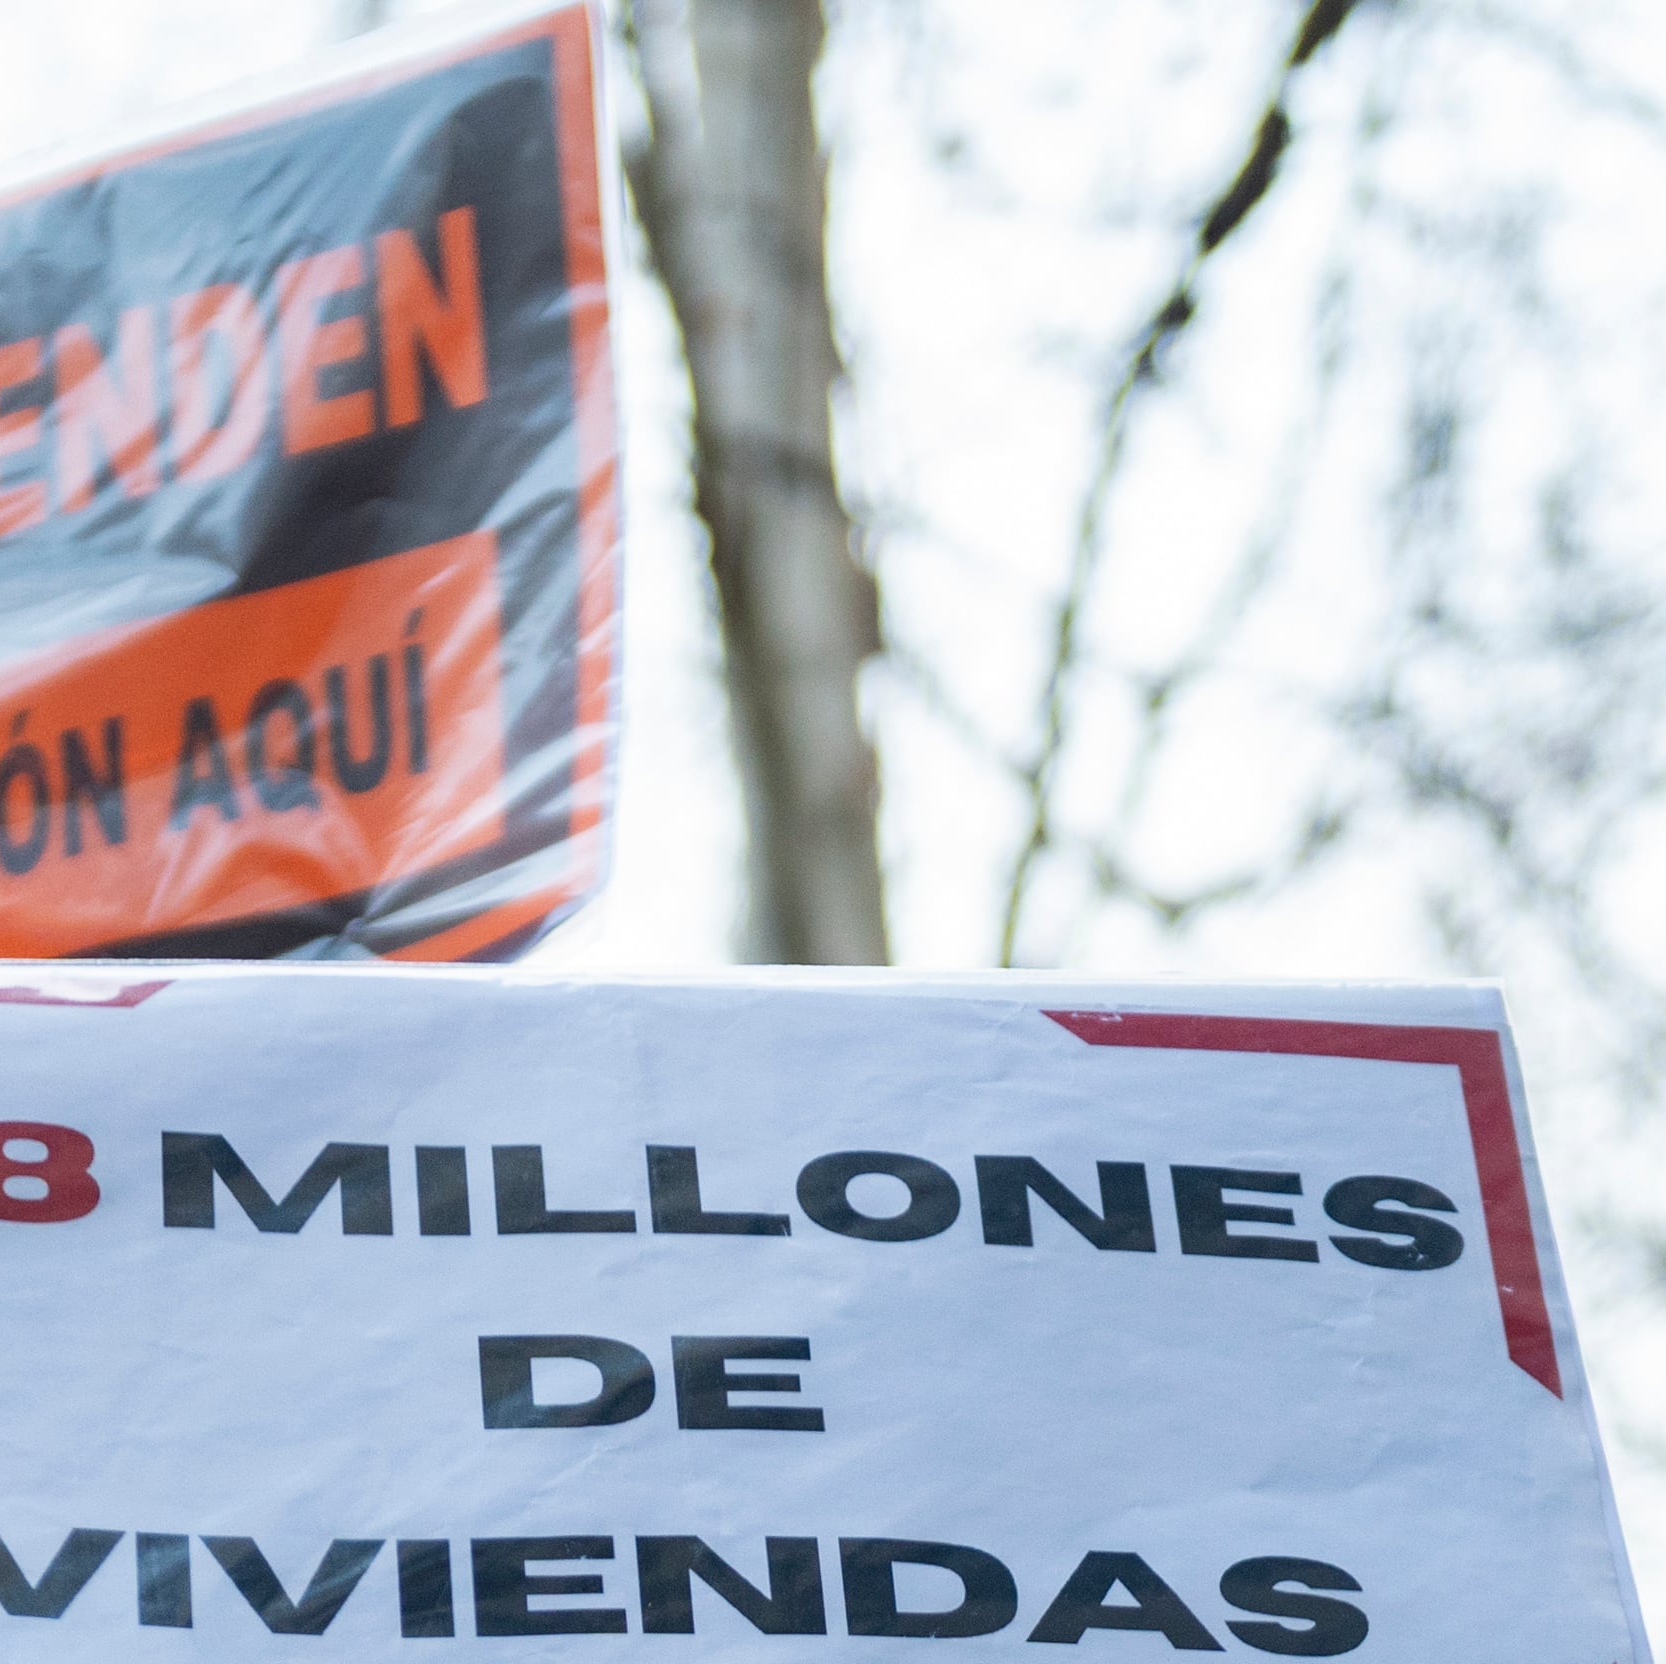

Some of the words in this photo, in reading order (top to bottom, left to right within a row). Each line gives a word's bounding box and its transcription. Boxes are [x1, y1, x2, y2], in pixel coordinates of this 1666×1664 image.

[172, 610, 431, 830] AQUÍ
[159, 1130, 1466, 1273] MILLONES
[477, 1333, 827, 1433] DE
